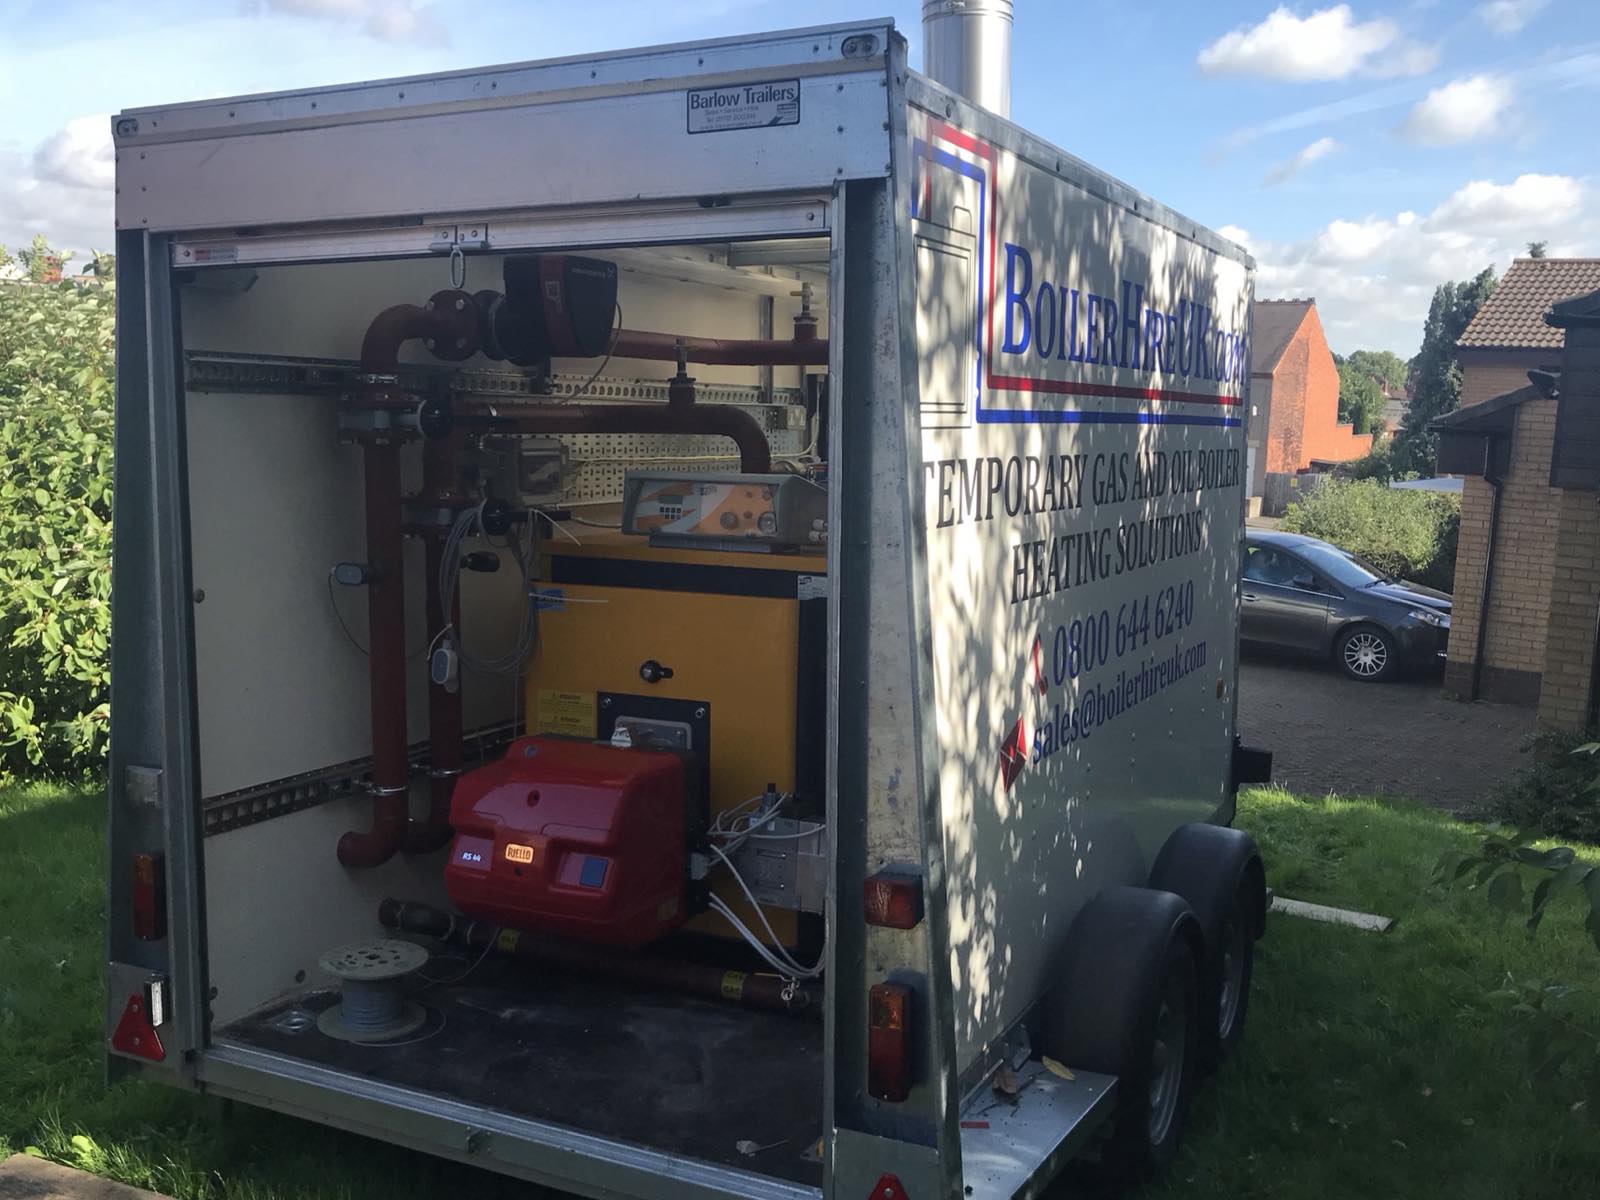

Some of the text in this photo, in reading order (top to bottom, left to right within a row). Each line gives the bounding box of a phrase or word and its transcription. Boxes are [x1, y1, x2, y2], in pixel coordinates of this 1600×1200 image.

[690, 85, 794, 110] Barlow Trailers
[1092, 453, 1129, 506] GAS
[1133, 451, 1166, 500] AND
[1171, 450, 1194, 496] OIL
[1198, 448, 1240, 492] BOILER
[1011, 511, 1202, 604] HEATING SOLUTIONS
[1053, 579, 1194, 686] 0800 644 6240
[1033, 641, 1206, 765] sales@boilerhireuk.com
[507, 847, 531, 859] RIELLO
